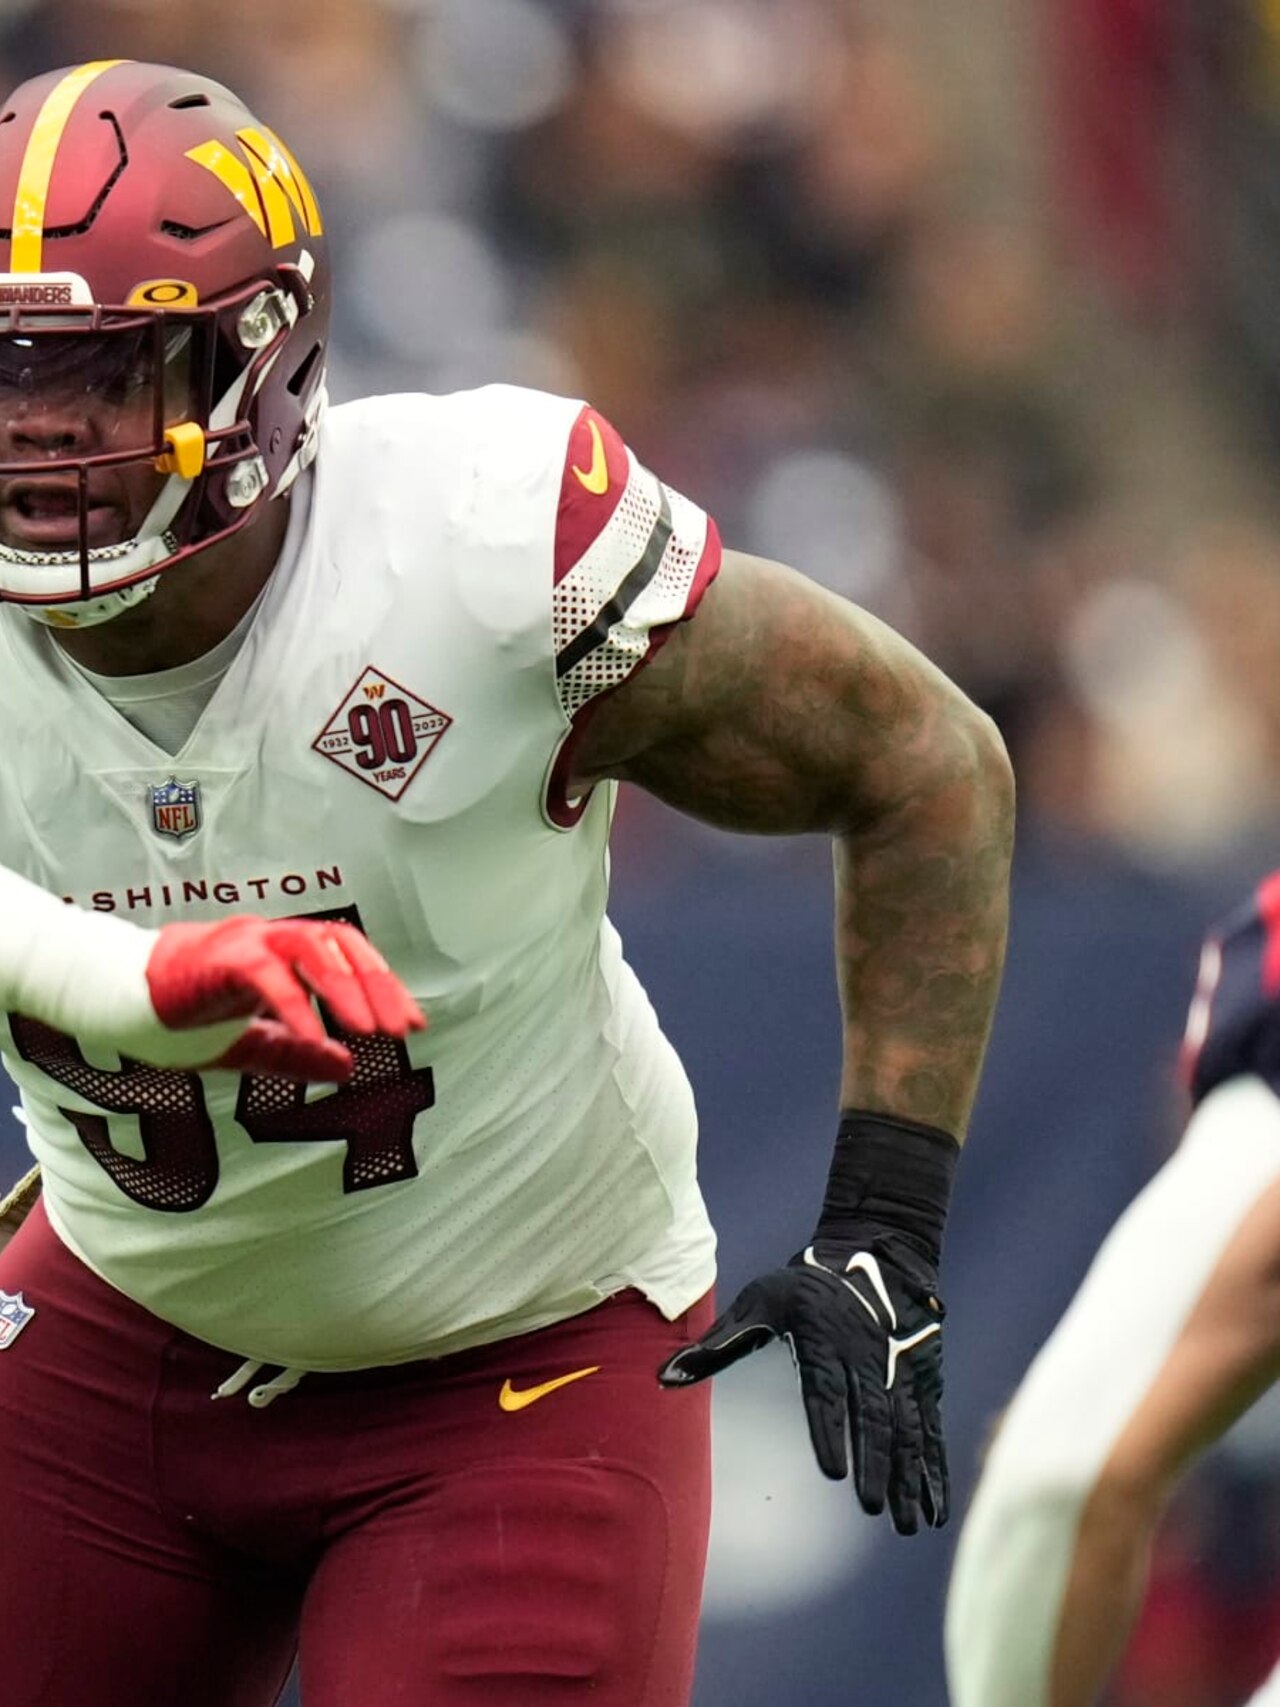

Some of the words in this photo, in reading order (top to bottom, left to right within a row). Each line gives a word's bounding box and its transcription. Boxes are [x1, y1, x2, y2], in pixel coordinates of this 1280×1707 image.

[322, 737, 349, 749] 1932
[347, 698, 418, 770] 90
[413, 717, 444, 732] 2022
[372, 767, 408, 783] YEARS
[158, 805, 194, 833] NFL
[62, 865, 343, 913] SHINGTON
[7, 903, 436, 1214] 94
